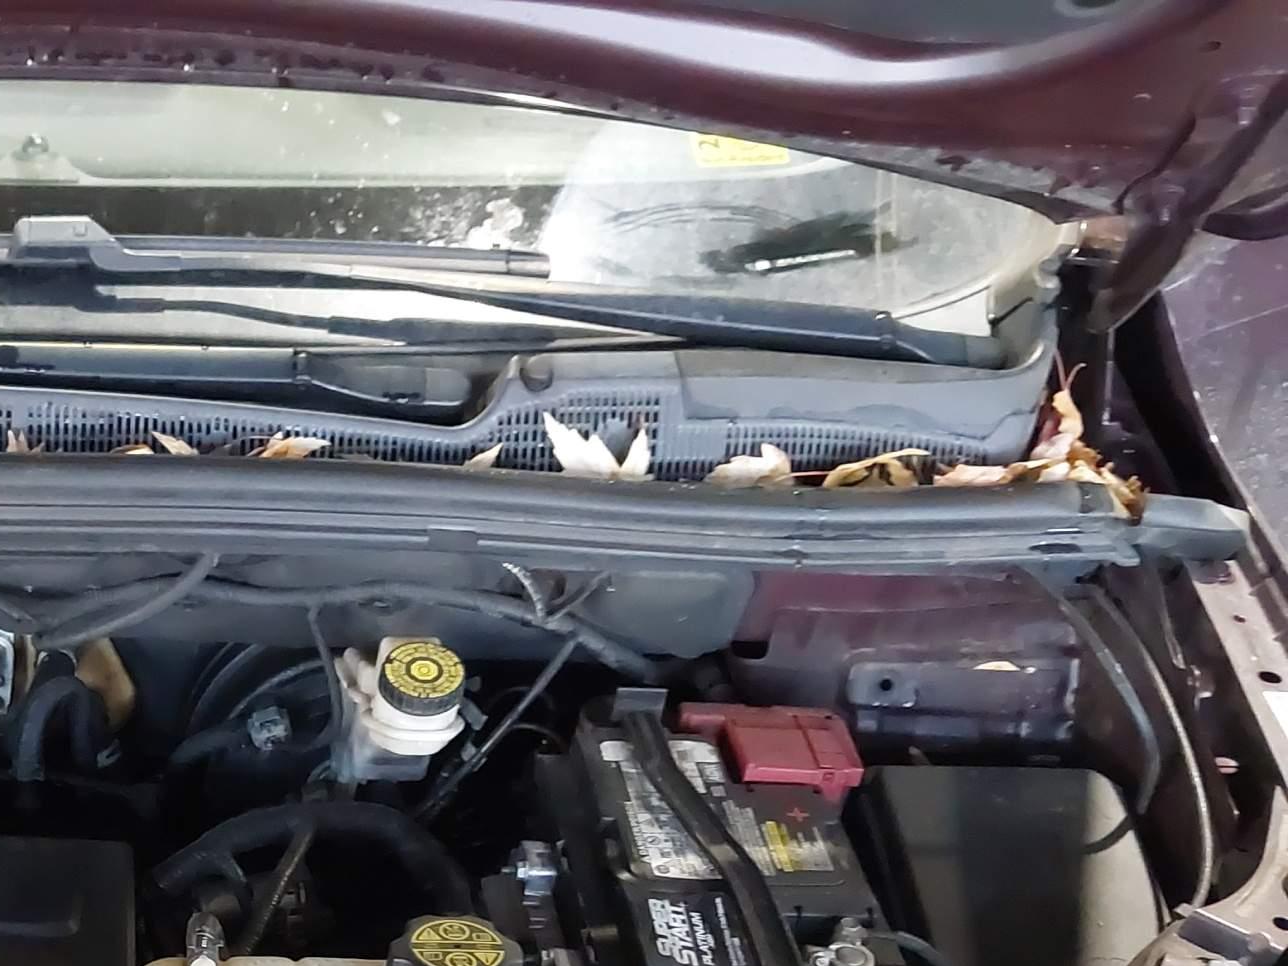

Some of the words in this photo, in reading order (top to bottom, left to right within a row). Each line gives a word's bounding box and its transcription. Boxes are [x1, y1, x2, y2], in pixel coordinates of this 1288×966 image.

[648, 898, 673, 957] SUPER
[669, 903, 699, 966] START
[690, 912, 715, 966] PLATINUM
